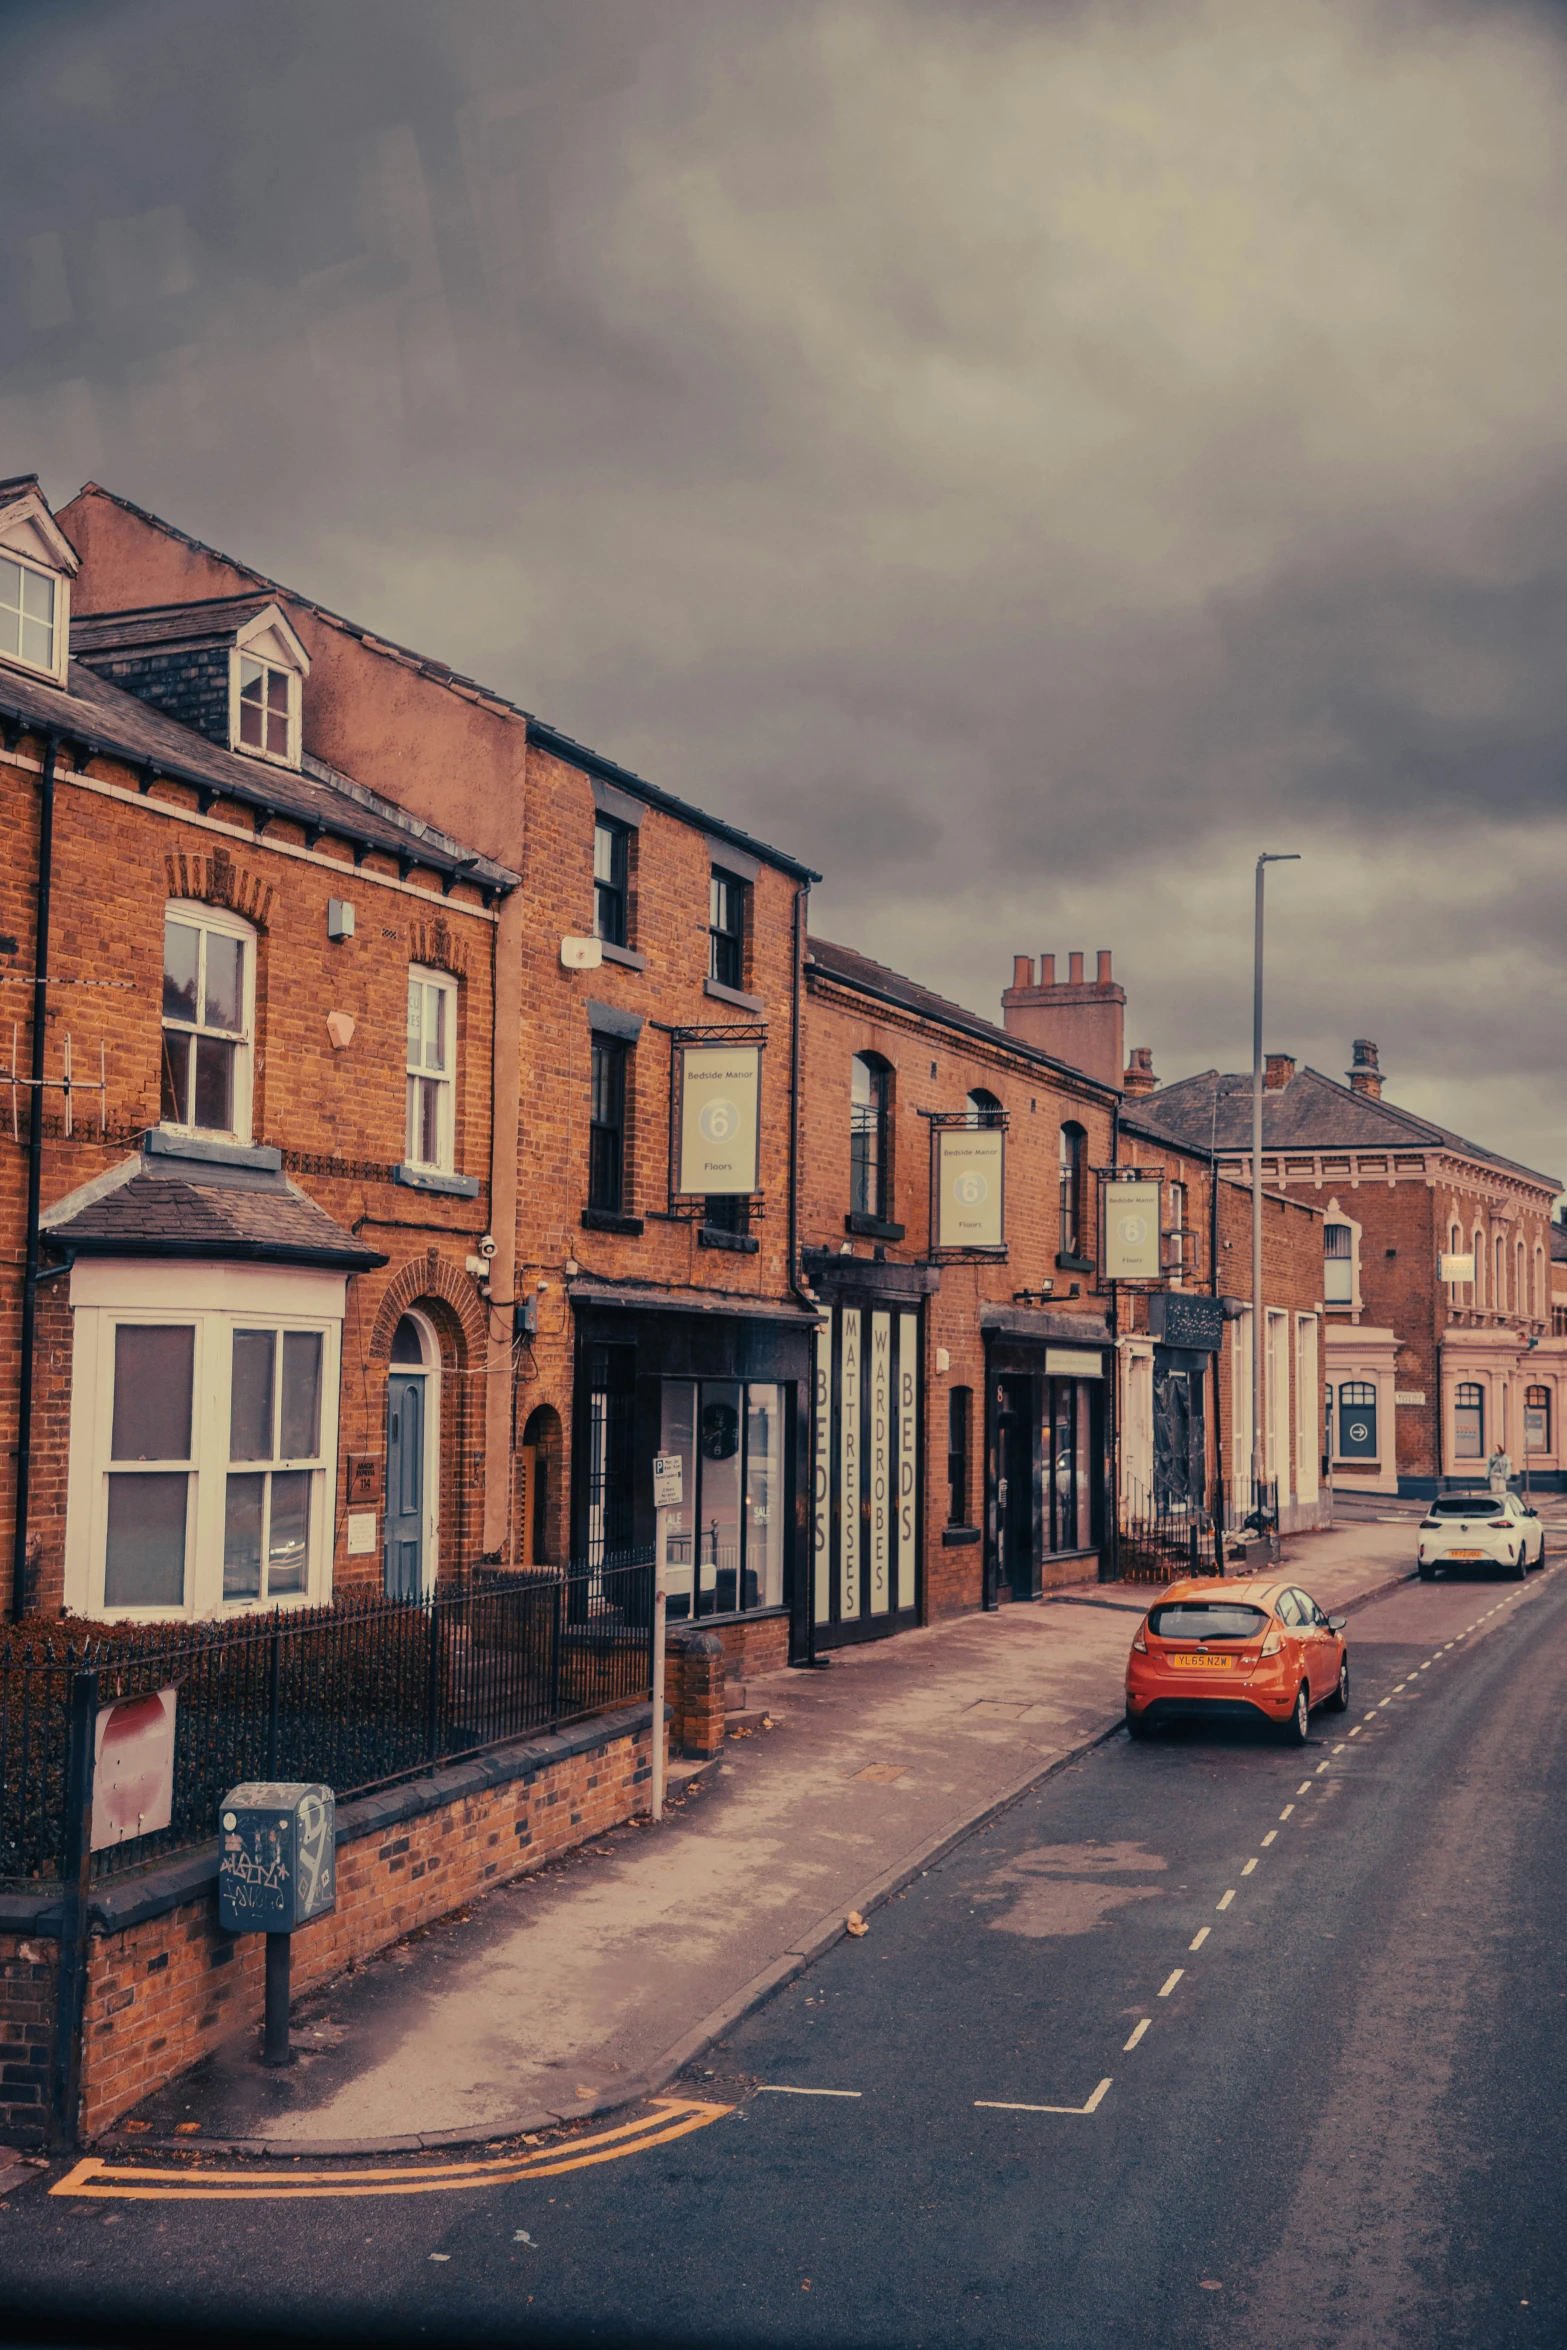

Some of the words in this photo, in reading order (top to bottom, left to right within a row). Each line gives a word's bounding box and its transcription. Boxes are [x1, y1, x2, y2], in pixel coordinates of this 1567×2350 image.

[687, 1072, 723, 1080] Bedside
[709, 1108, 728, 1137] 6
[704, 1163, 732, 1171] Floors
[963, 1177, 978, 1202] 6
[1125, 1221, 1139, 1242] 6
[997, 1385, 1003, 1402] 8
[815, 1369, 827, 1552] BEDS
[845, 1313, 857, 1611] MATTRESSES
[874, 1330, 887, 1591] WARDROBES
[902, 1373, 913, 1541] BEDS
[657, 1461, 663, 1473] P
[361, 1478, 370, 1488] 114
[667, 1511, 682, 1525] ALE
[754, 1506, 771, 1518] SALE
[1179, 1656, 1204, 1665] YL65
[1207, 1656, 1226, 1666] NZW
